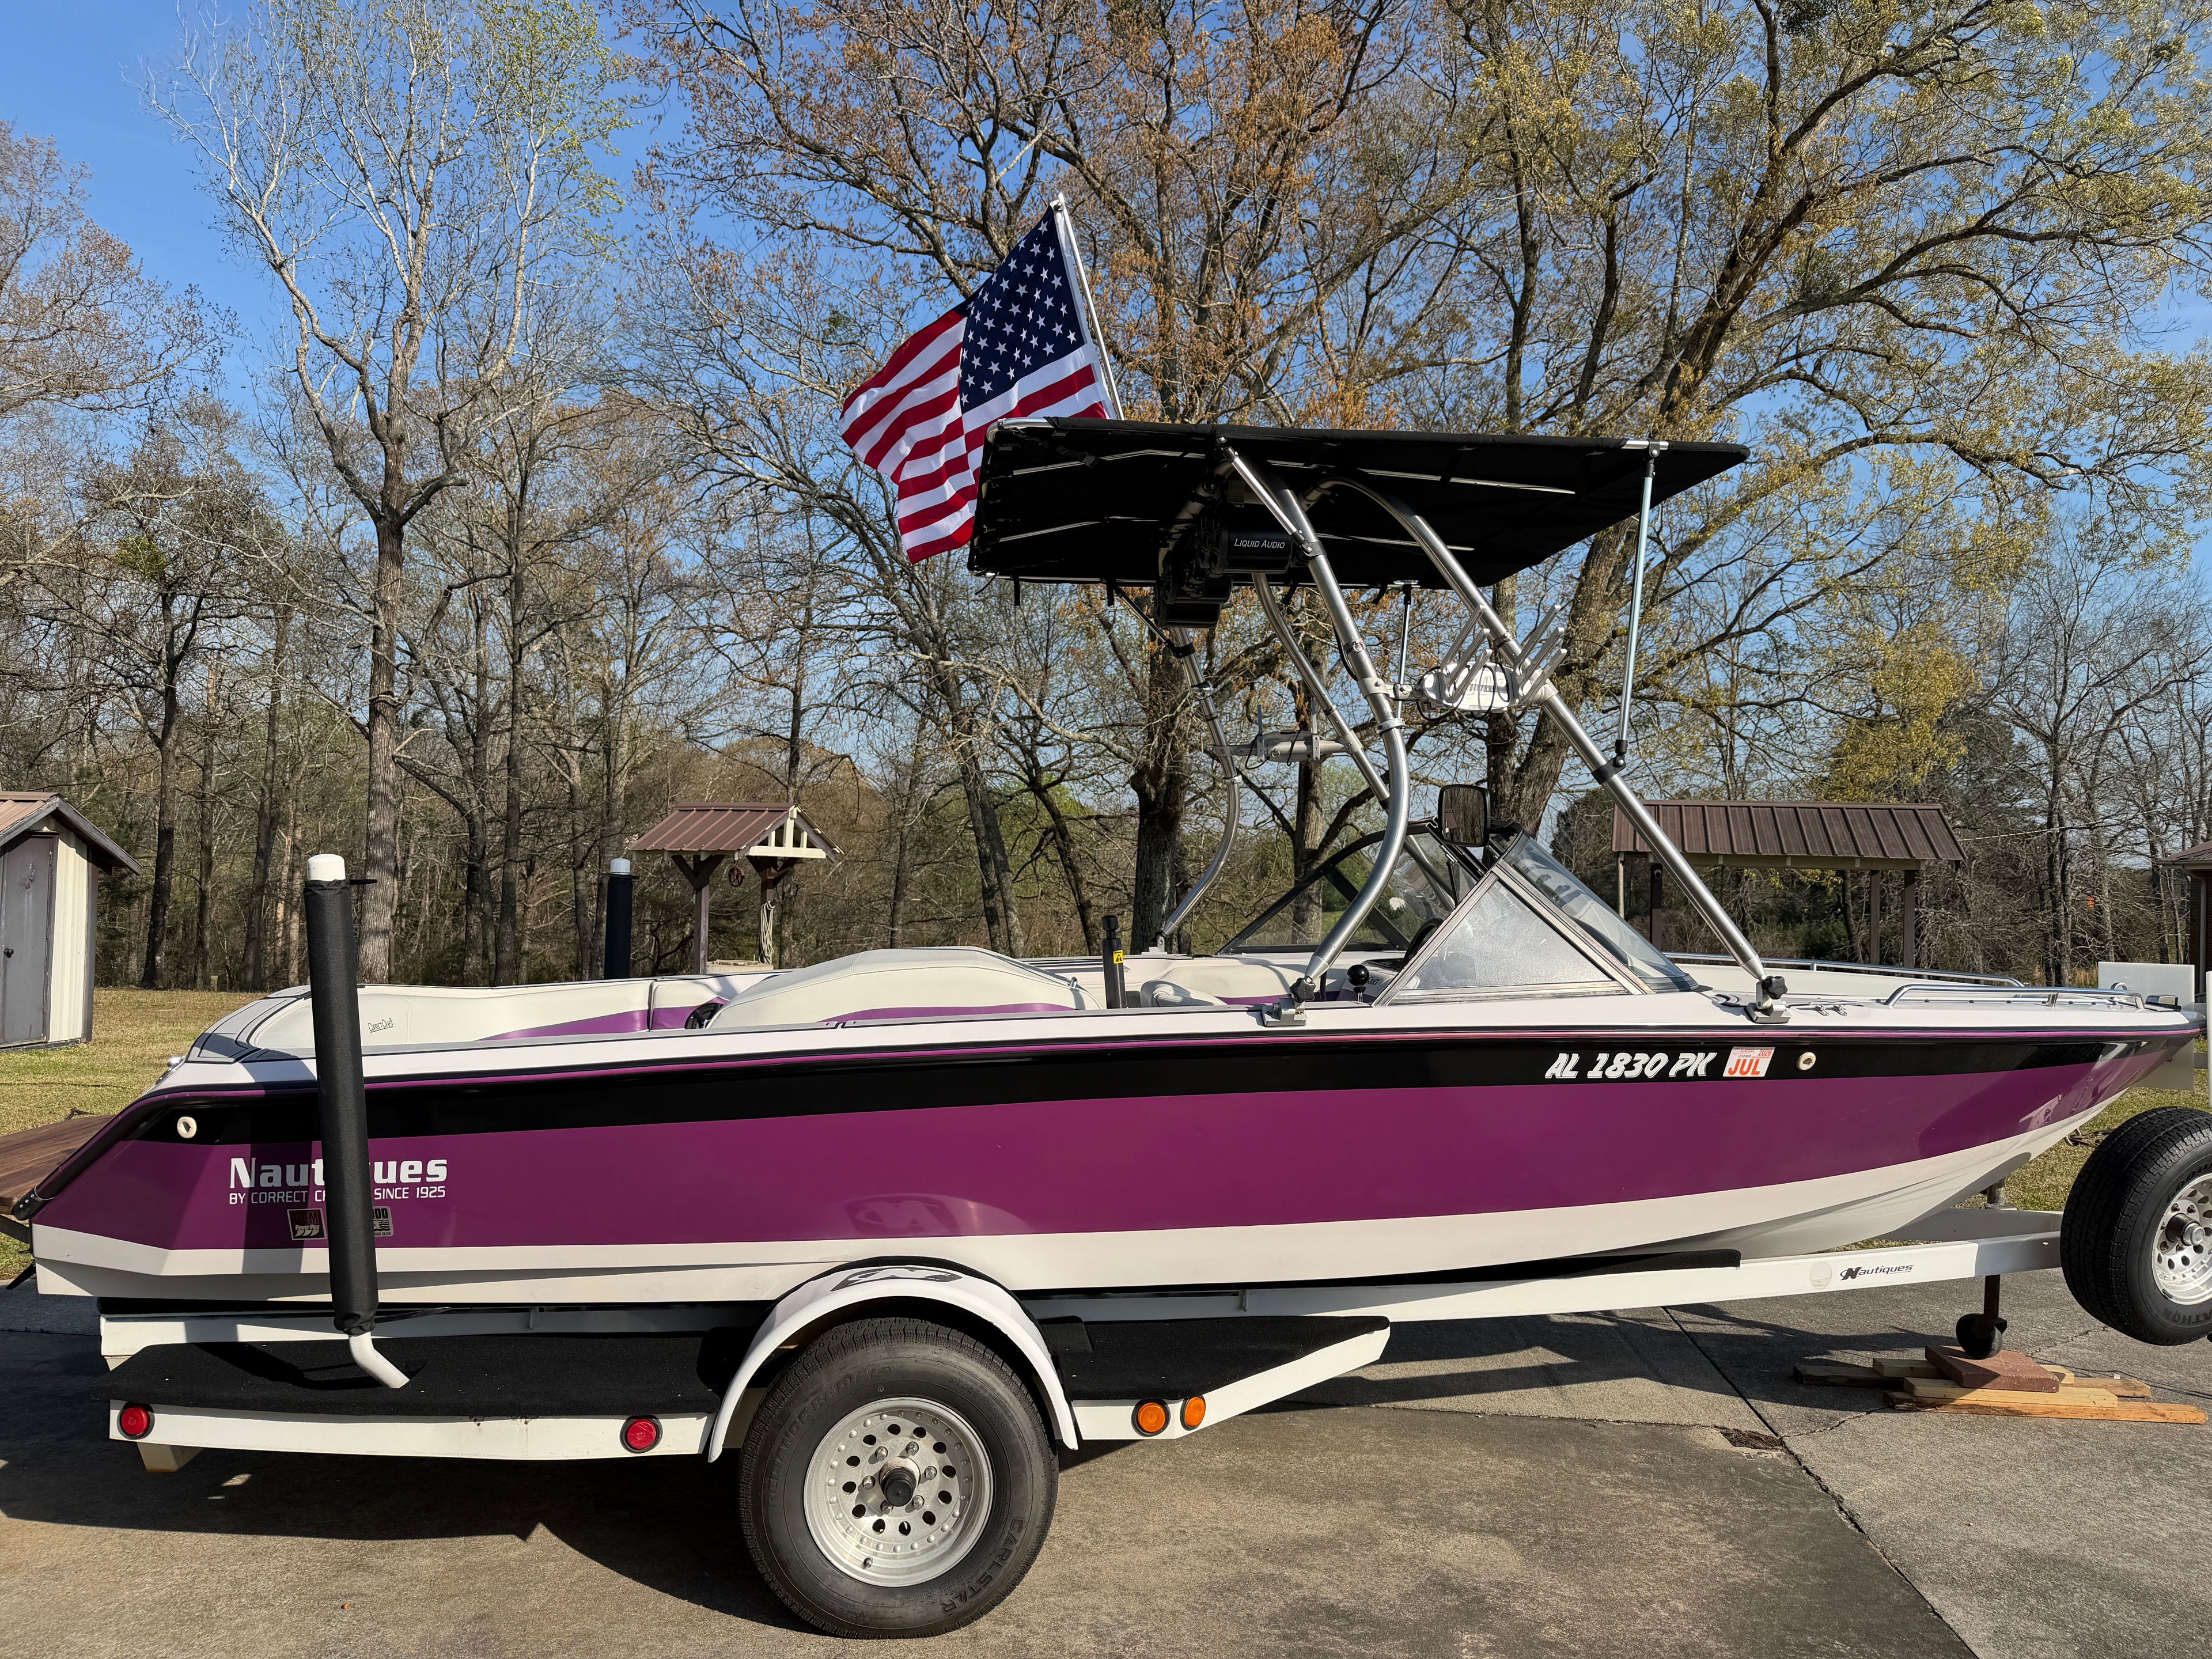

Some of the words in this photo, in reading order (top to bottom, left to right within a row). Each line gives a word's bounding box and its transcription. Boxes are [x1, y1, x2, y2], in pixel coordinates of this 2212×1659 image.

[1260, 540, 1285, 548] AUDIO
[1544, 1053, 1580, 1078] AL
[1587, 1052, 1669, 1078] 1830
[1669, 1052, 1717, 1077] PK
[1728, 1059, 1760, 1075] JUL
[230, 1158, 447, 1188] Nautues
[229, 1192, 246, 1205] BY
[251, 1191, 308, 1203] CORRECT
[374, 1187, 409, 1200] SINCE
[416, 1185, 445, 1198] 1925
[373, 1208, 388, 1219] 00
[1840, 1265, 1914, 1281] Nautiques
[940, 1517, 1024, 1613] CARLSTAR
